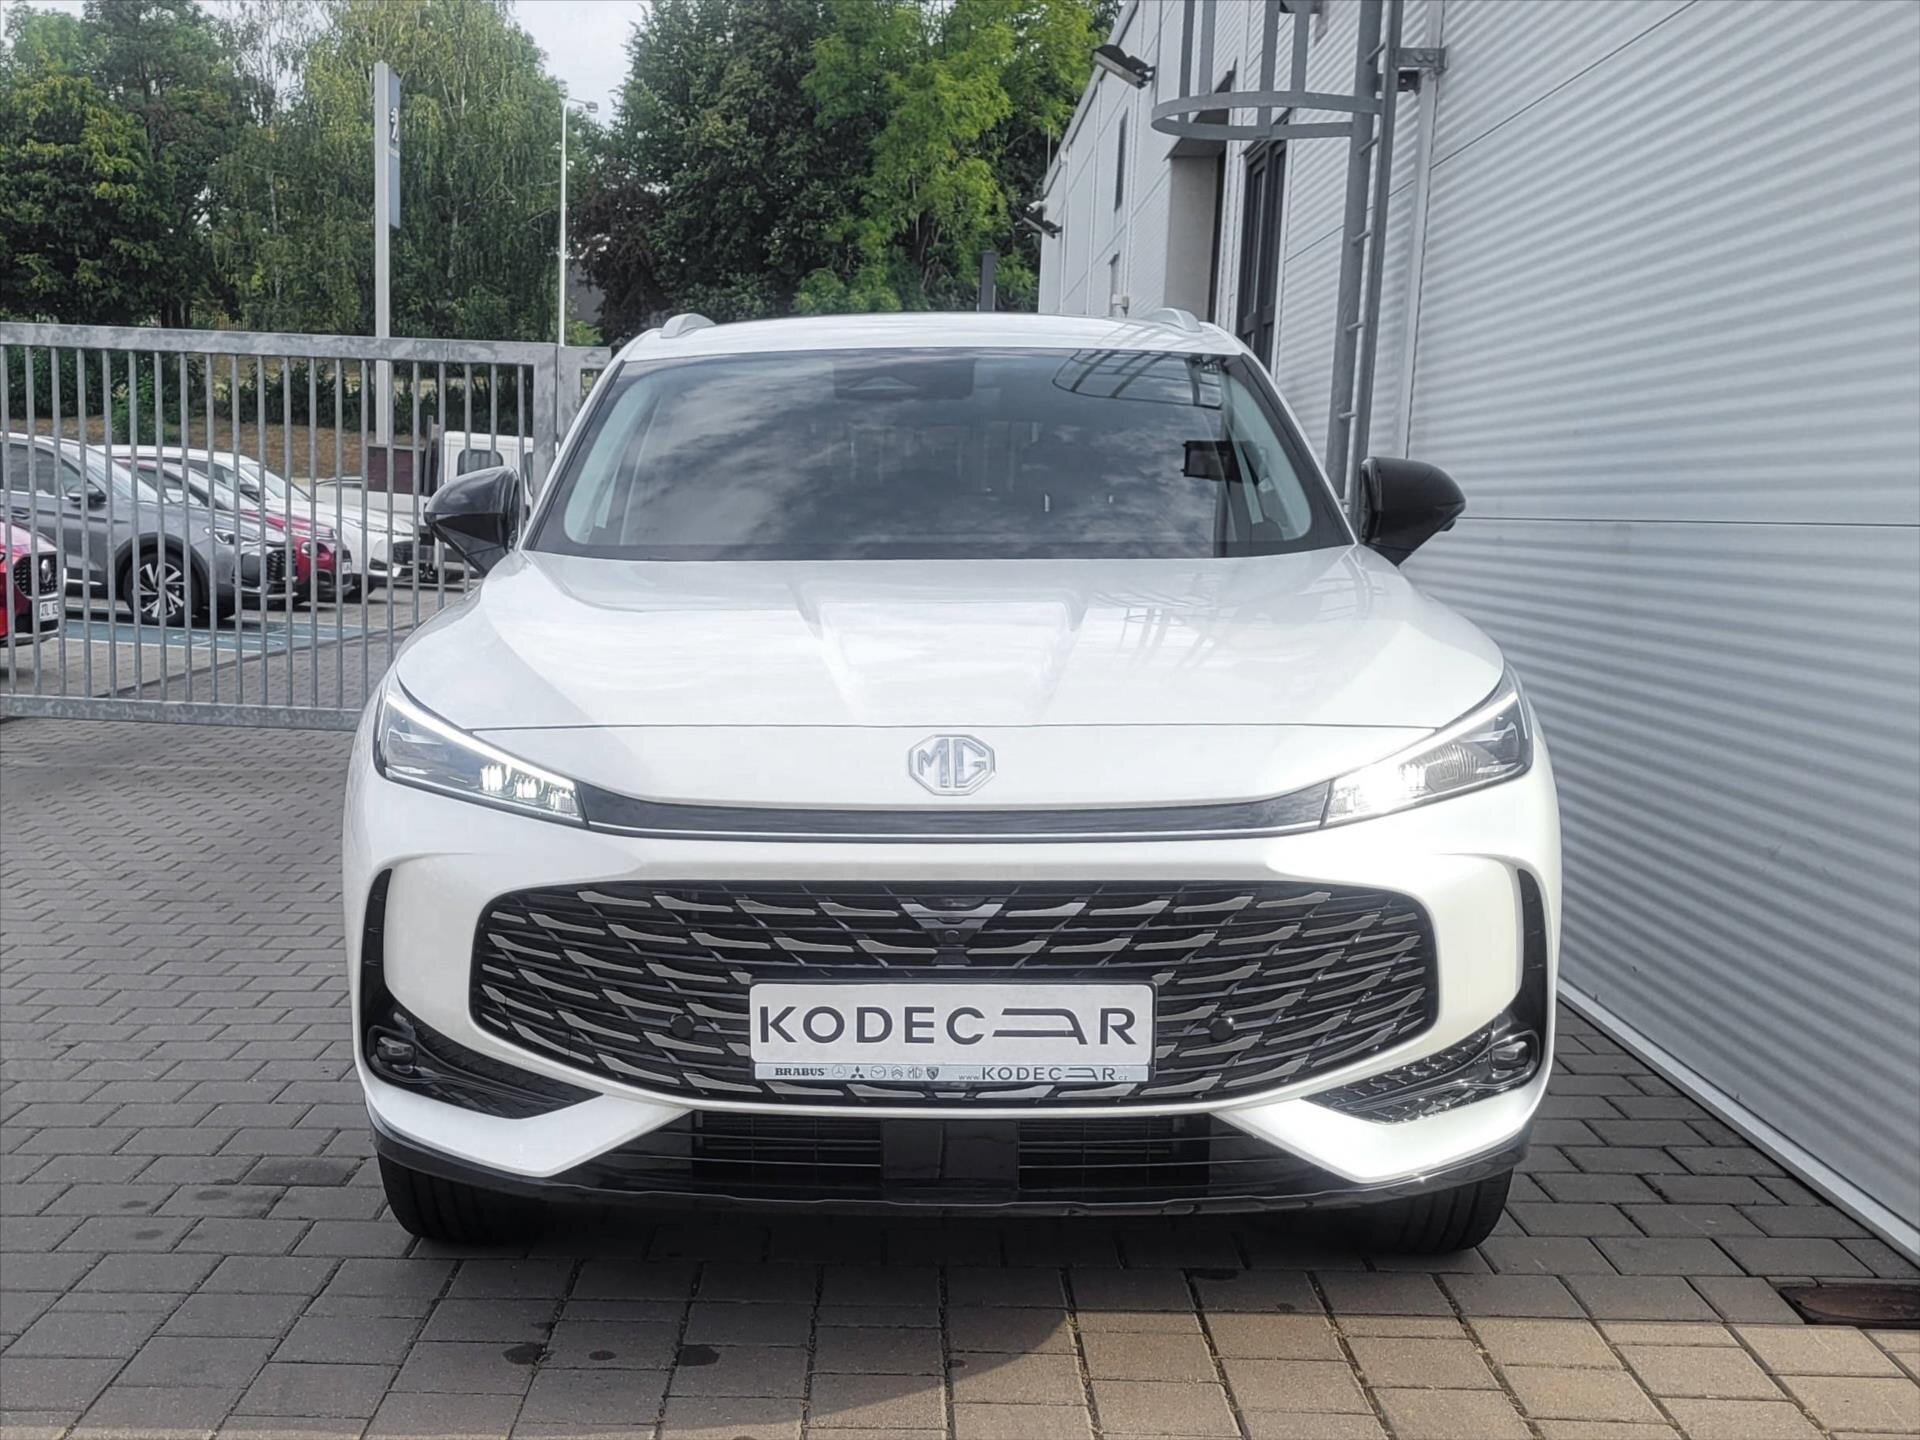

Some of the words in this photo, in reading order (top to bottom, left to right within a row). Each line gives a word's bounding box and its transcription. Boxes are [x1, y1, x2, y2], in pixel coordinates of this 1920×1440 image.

[916, 737, 988, 789] MG
[759, 1005, 1137, 1046] KODECAR
[774, 1067, 825, 1077] BRABUS
